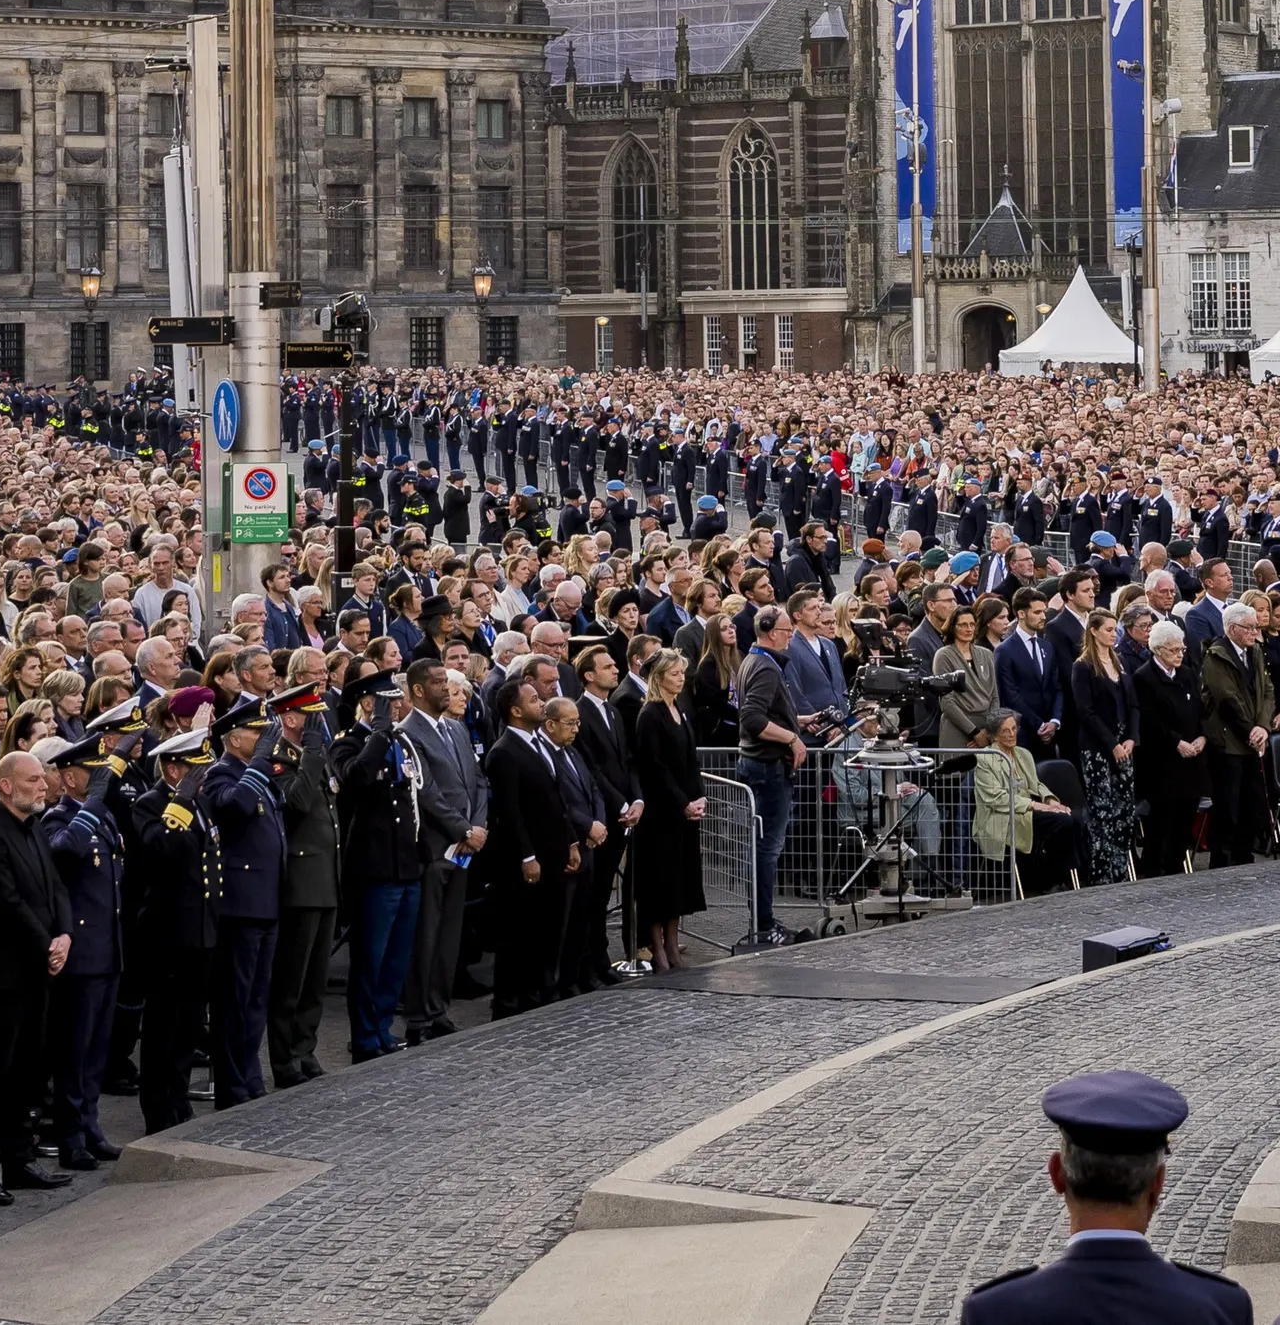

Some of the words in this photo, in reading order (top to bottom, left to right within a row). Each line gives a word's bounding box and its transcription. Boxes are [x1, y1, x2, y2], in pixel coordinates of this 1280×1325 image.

[313, 345, 334, 353] Berlage
[235, 515, 243, 525] P
[235, 528, 243, 538] P
